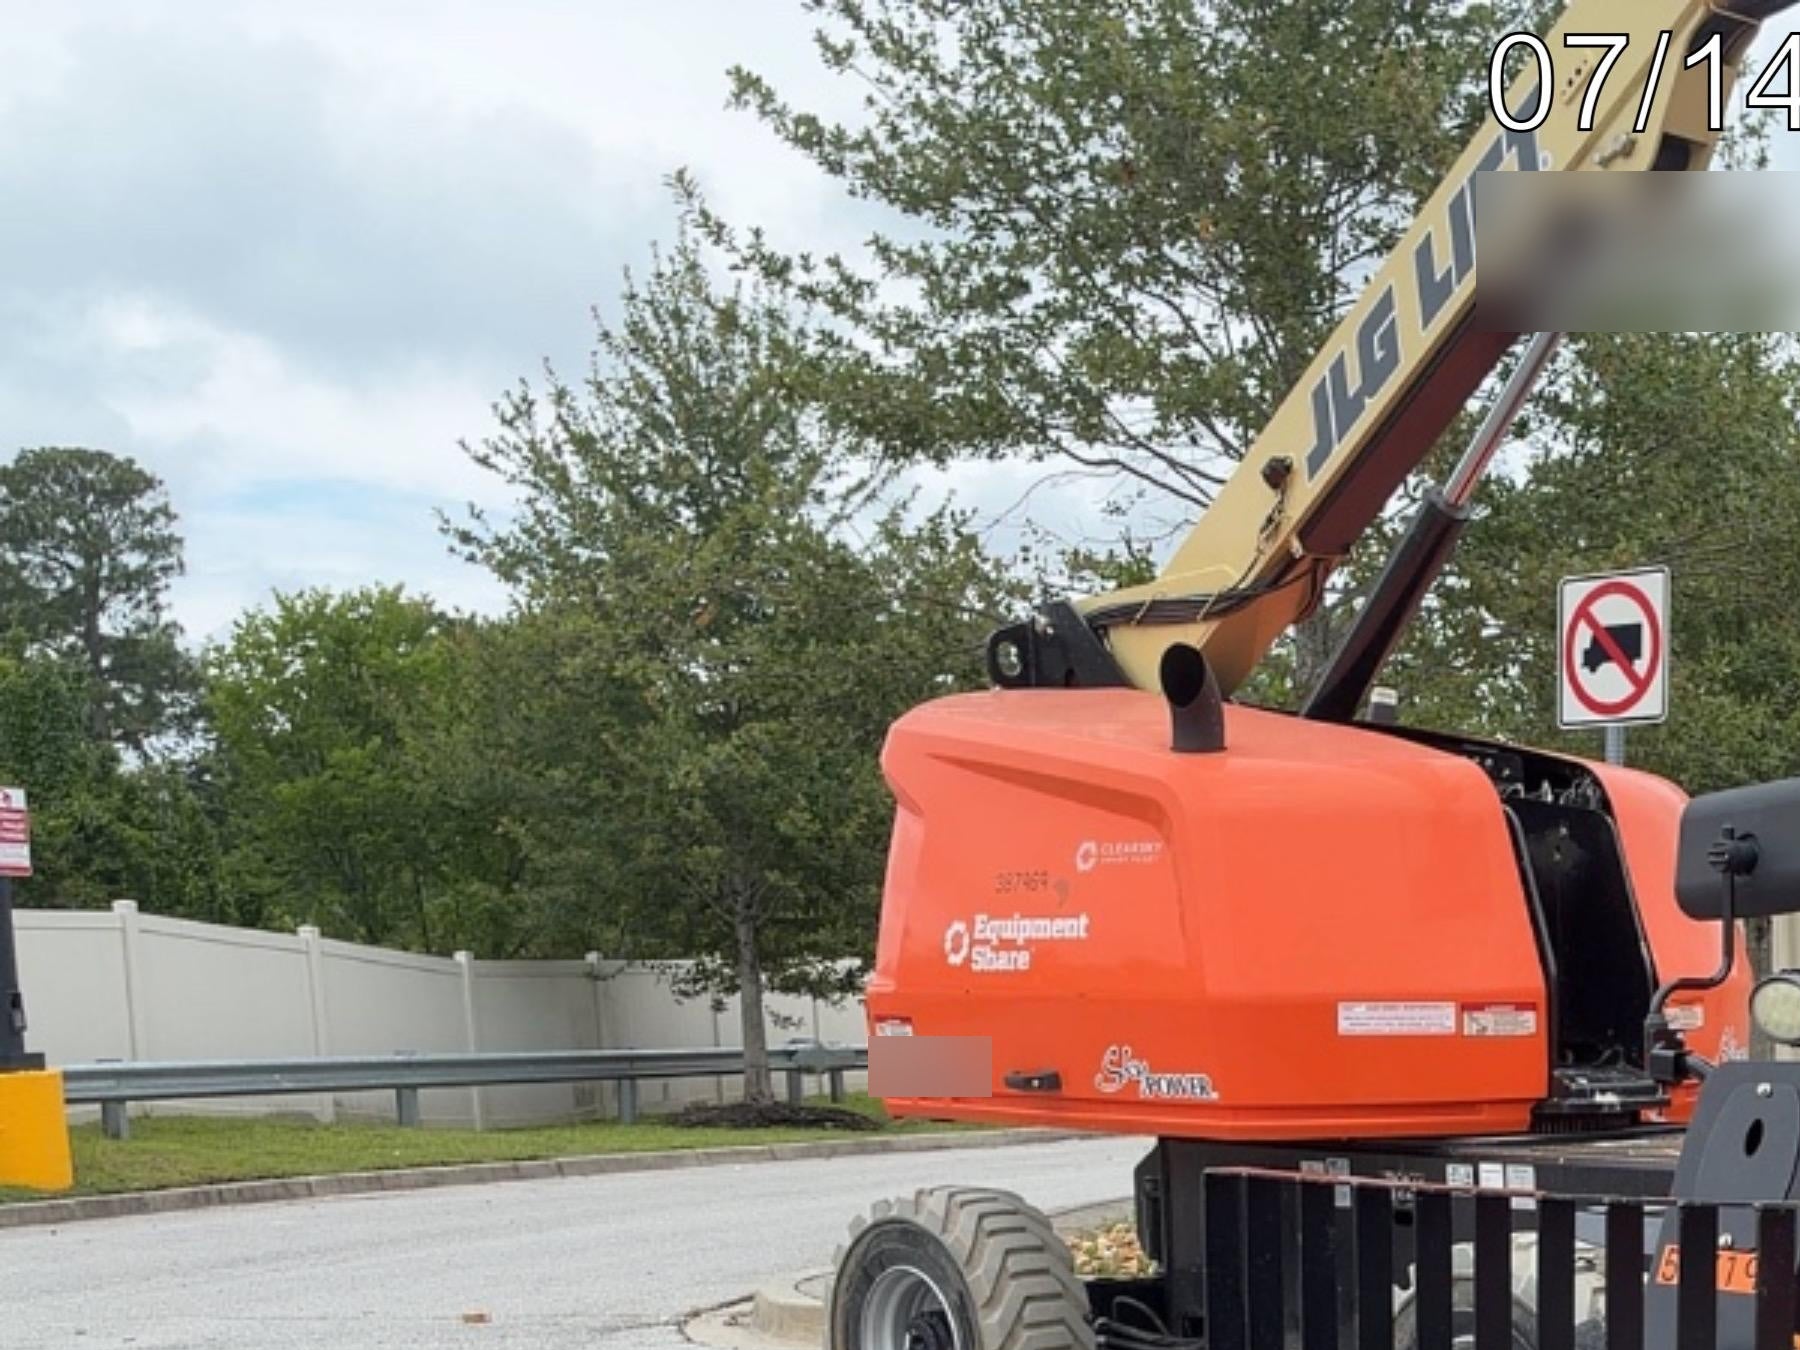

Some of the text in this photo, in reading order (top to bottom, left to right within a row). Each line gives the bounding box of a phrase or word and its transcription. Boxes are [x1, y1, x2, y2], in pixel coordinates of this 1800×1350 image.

[1307, 284, 1401, 482] JLG
[973, 912, 1090, 945] Equipment
[970, 945, 1031, 972] Share
